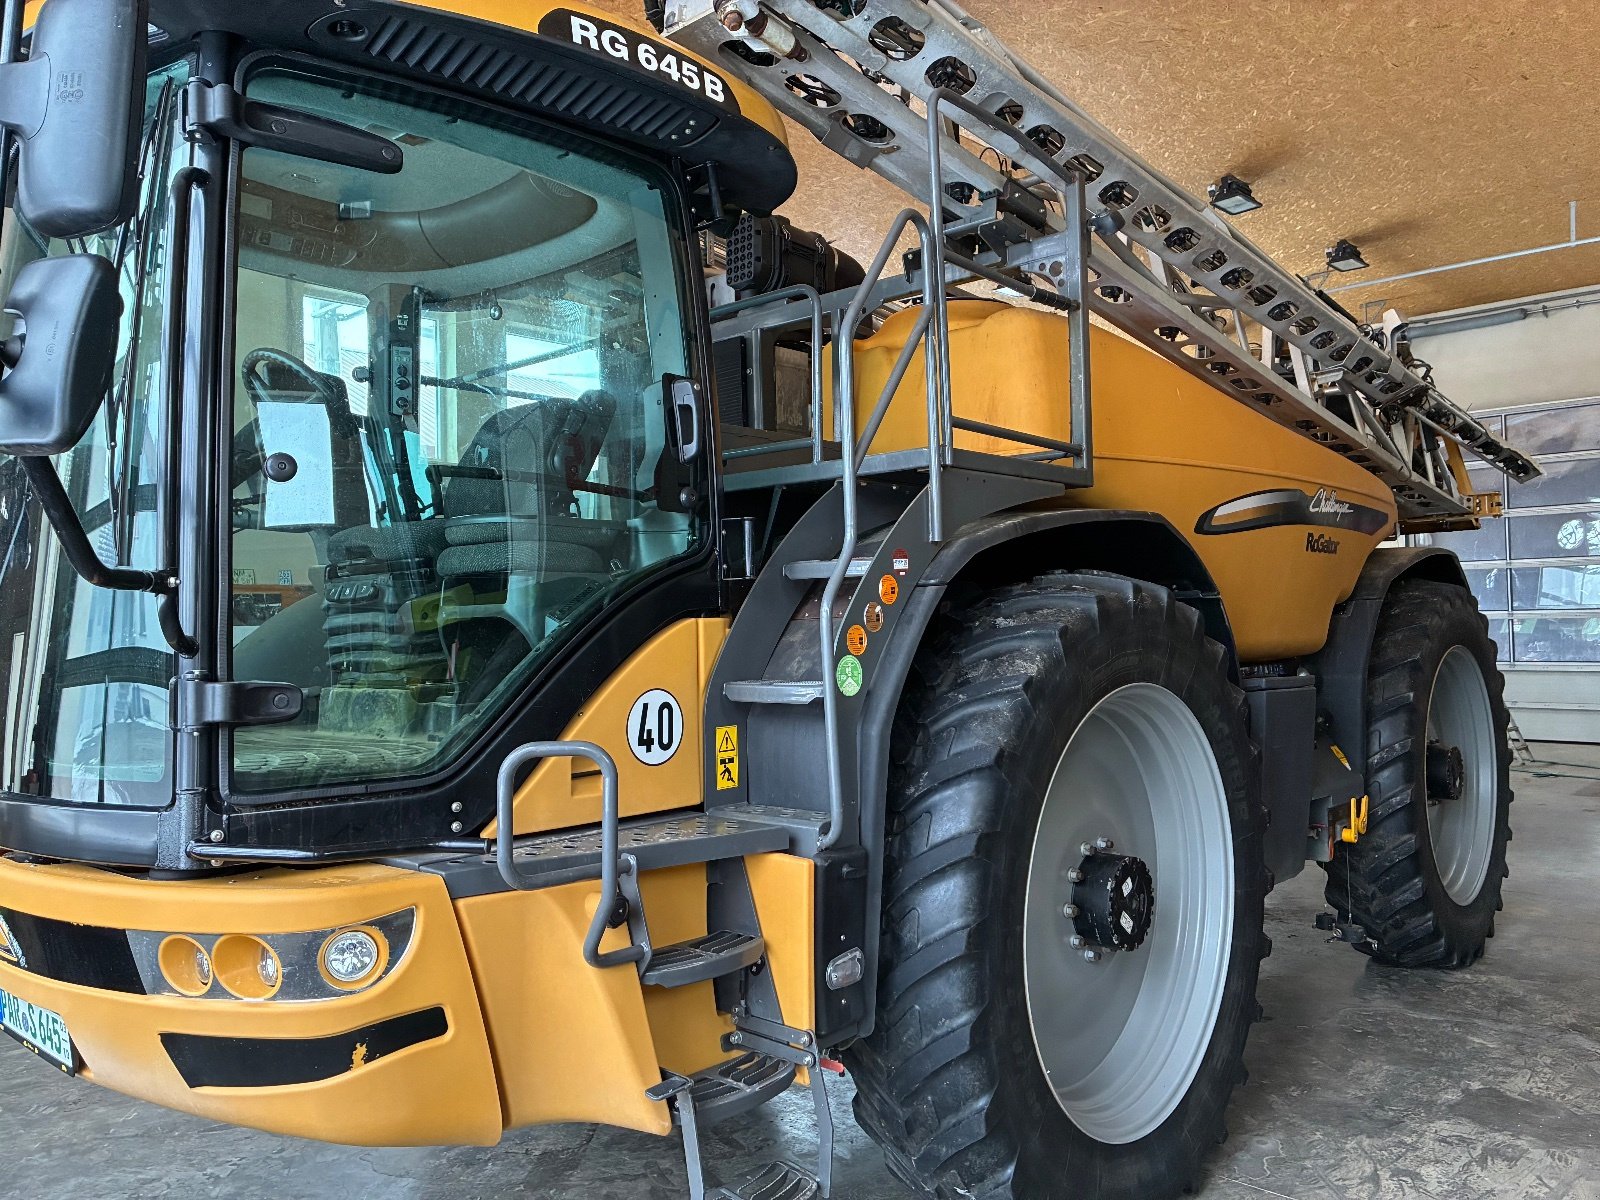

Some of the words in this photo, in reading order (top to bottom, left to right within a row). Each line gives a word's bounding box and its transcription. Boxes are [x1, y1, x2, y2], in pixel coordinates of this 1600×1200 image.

[570, 15, 629, 61] RG
[1305, 532, 1341, 555] RoGator
[637, 701, 674, 753] 40
[1, 988, 23, 1030] PAR
[27, 1002, 38, 1040] S
[38, 1009, 62, 1055] 645
